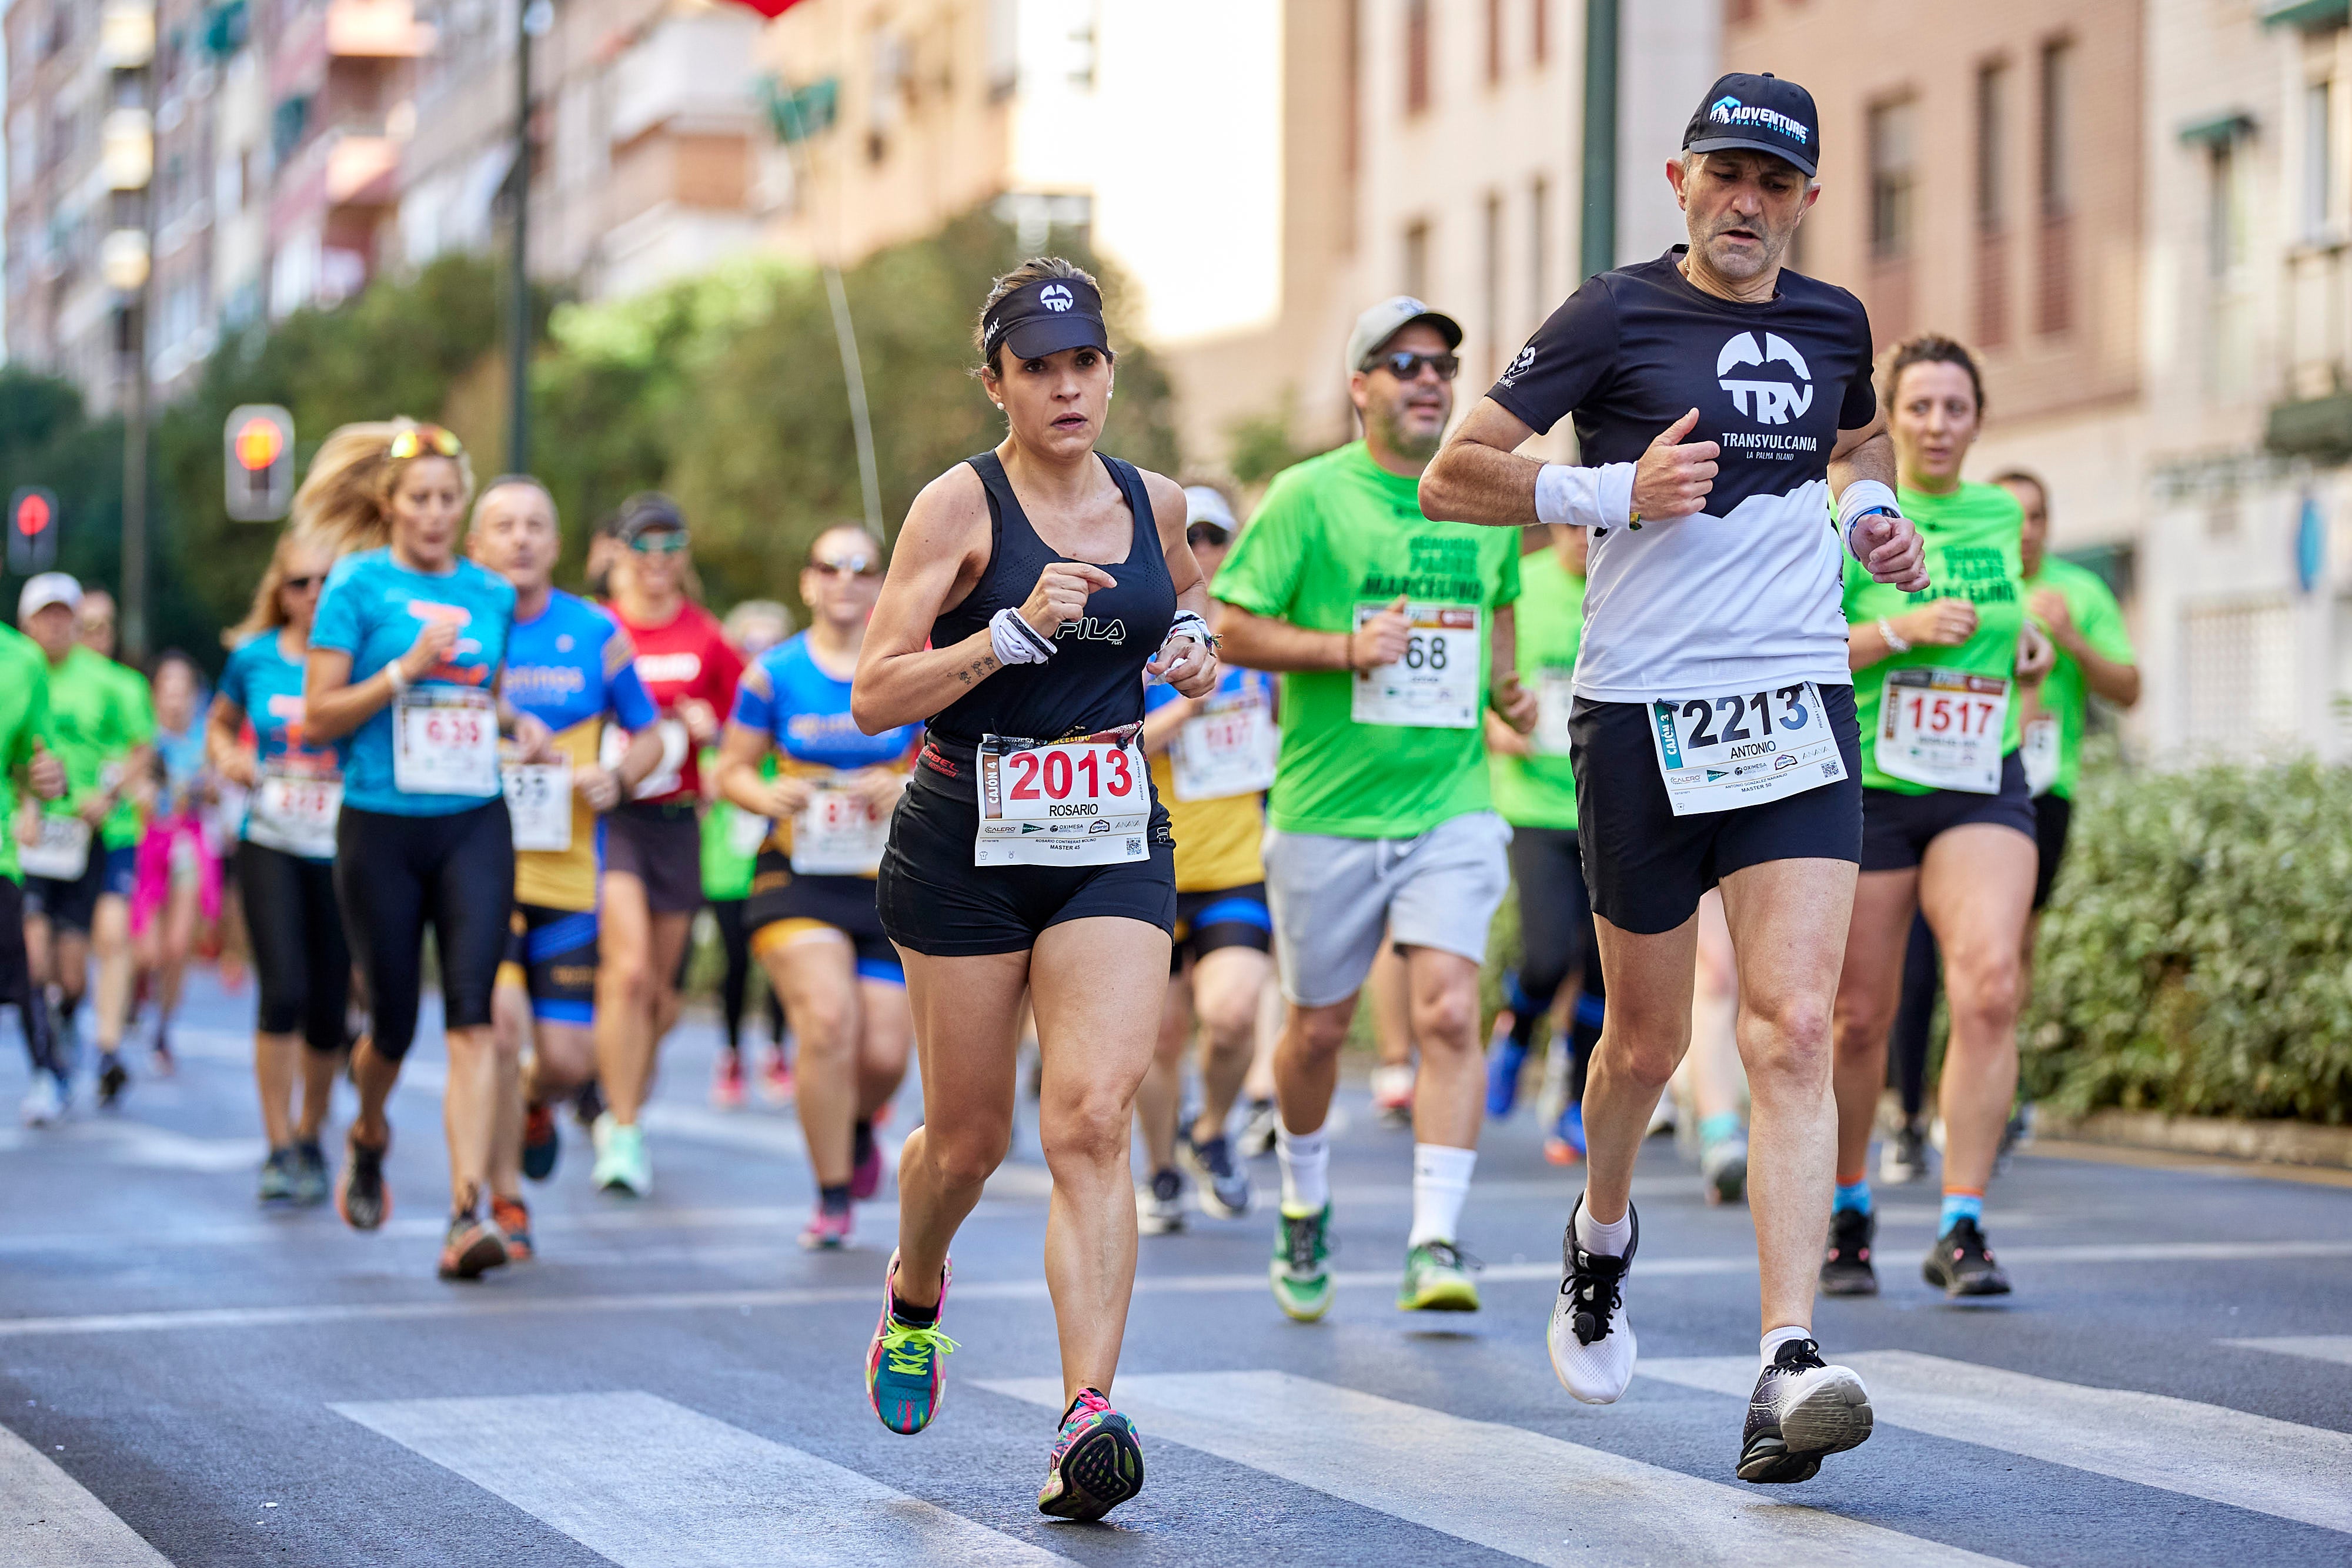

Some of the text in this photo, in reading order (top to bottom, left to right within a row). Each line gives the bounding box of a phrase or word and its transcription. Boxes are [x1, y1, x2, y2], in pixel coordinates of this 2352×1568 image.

[1730, 106, 1808, 139] ADVENTURE
[1767, 122, 1806, 145] RUNNING
[1722, 432, 1817, 452] TRANSVULCANIA
[1746, 451, 1794, 461] LA PALMA ISLAND
[1055, 617, 1126, 641] FILA
[1682, 686, 1809, 750] 2213
[1909, 696, 1995, 736] 1517
[1660, 714, 1678, 755] CAJÓN 3
[1730, 740, 1776, 760] ANTONIO
[1802, 746, 1830, 760] ANAYA
[1009, 748, 1132, 800] 2013
[1743, 763, 1768, 771] OXIMESA
[1767, 773, 1788, 781] NARANJO
[985, 771, 999, 804] CAJÓN
[1672, 775, 1700, 783] CALERO
[1741, 784, 1765, 793] MASTER
[1049, 803, 1098, 817] ROSARIO
[1115, 820, 1141, 829] ANAYA
